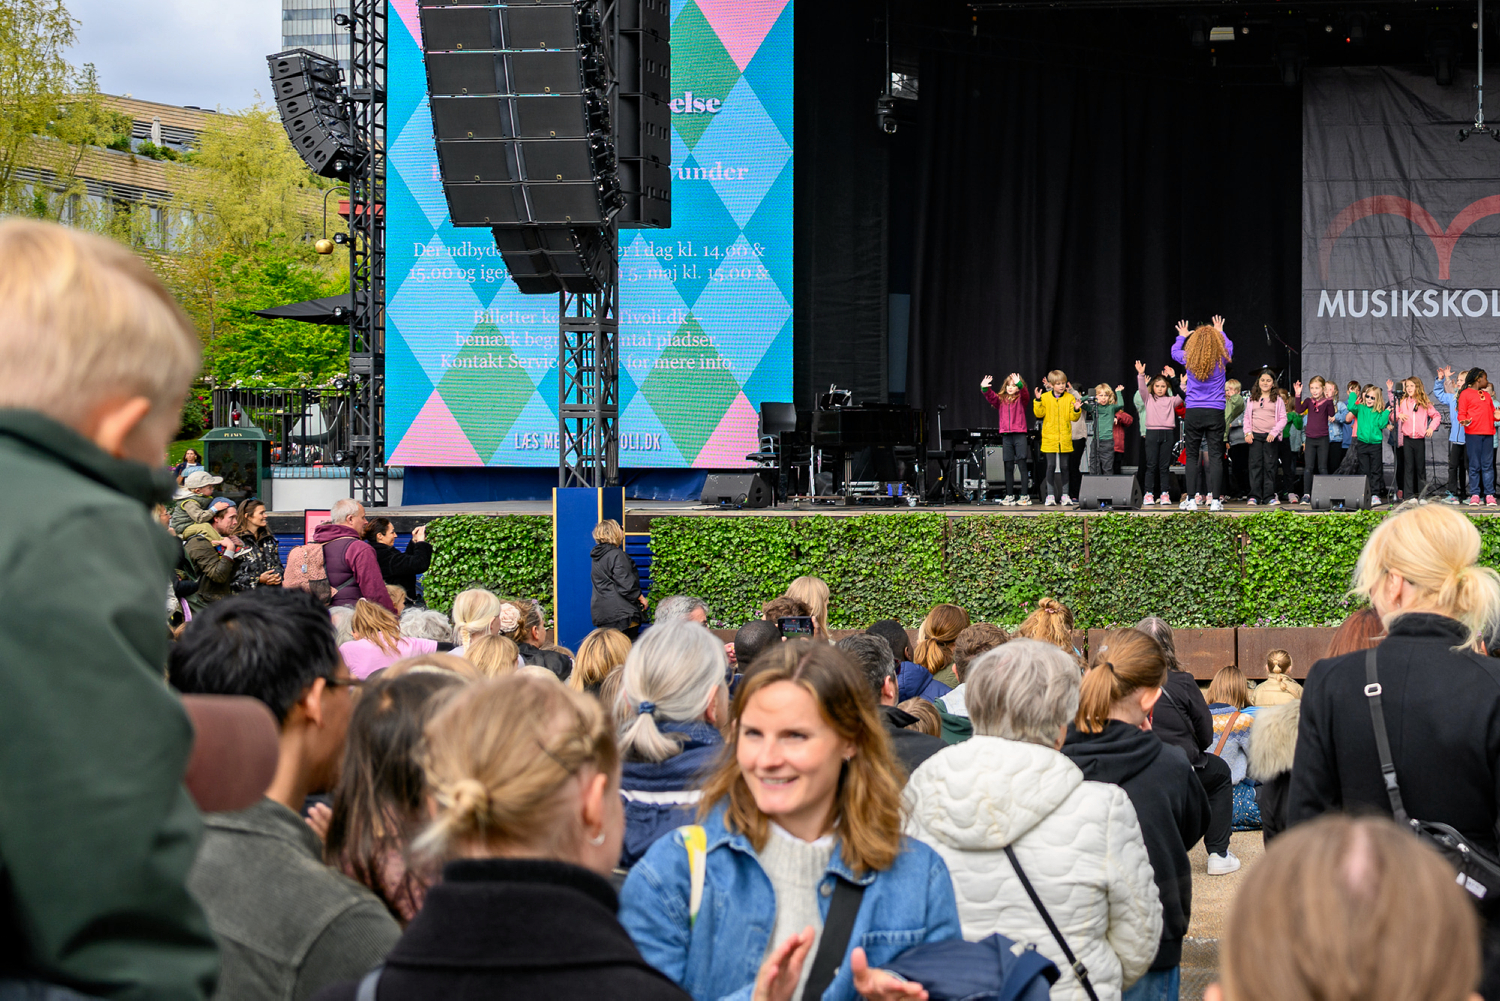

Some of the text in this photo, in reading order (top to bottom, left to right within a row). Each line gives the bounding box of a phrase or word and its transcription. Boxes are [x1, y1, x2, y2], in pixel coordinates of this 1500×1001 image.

[677, 161, 749, 181] under
[413, 242, 444, 257] Der
[644, 241, 673, 260] dag
[677, 241, 697, 257] kl.
[703, 245, 748, 260] 14.00
[753, 242, 766, 257] &
[410, 268, 453, 282] 15.00
[457, 268, 475, 282] og
[648, 267, 677, 283] maj
[683, 264, 701, 279] kl.
[708, 268, 751, 282] 15.00
[755, 264, 770, 280] &
[474, 308, 540, 324] Billetter
[456, 331, 524, 347] bemærk
[618, 331, 651, 347] ntal
[657, 331, 720, 351] pladser.
[441, 353, 504, 369] Kontakt
[627, 353, 651, 369] for
[655, 357, 696, 369] mere
[515, 432, 540, 449] LÆS
